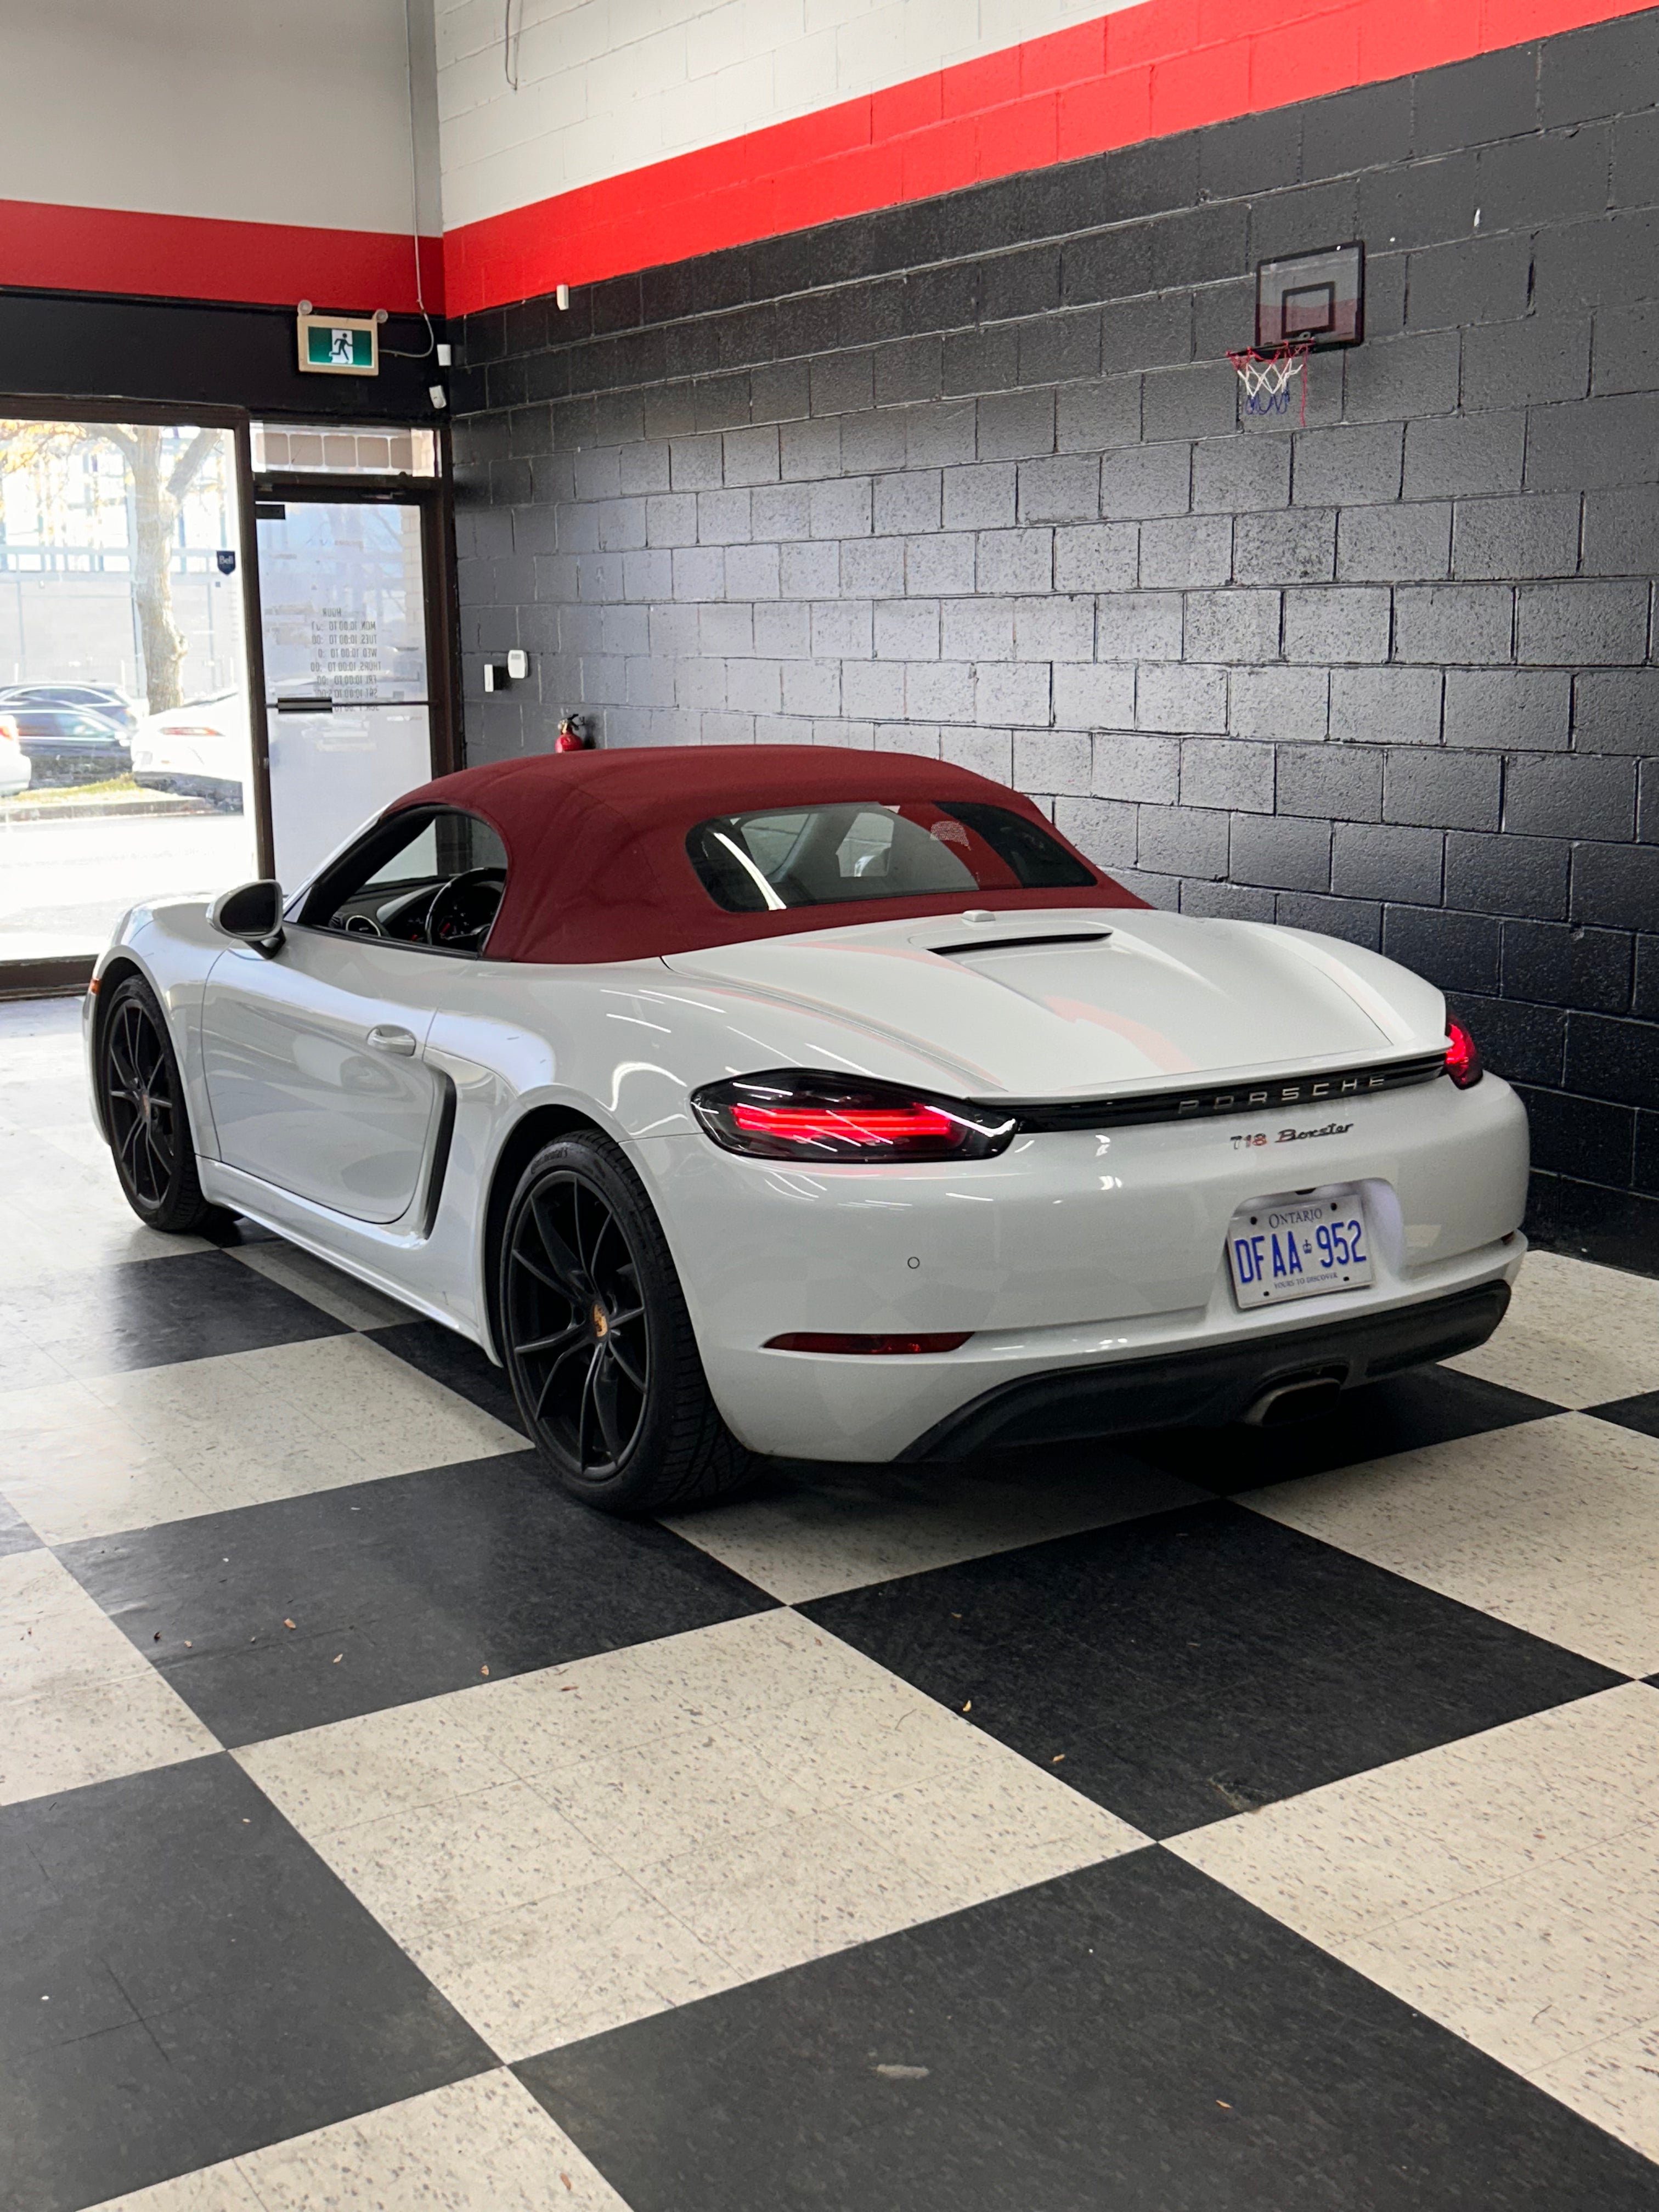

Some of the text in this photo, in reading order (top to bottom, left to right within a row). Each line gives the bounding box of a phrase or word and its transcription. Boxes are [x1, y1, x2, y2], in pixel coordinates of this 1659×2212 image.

[219, 556, 234, 564] Bell
[1178, 1077, 1384, 1114] PORSCHE
[1230, 1123, 1354, 1150] 718 Boxster
[1269, 1208, 1323, 1228] ONTARIO
[1234, 1220, 1367, 1283] DFAA 952
[1274, 1280, 1295, 1289] YOURS
[1306, 1272, 1338, 1283] DISCOVER
